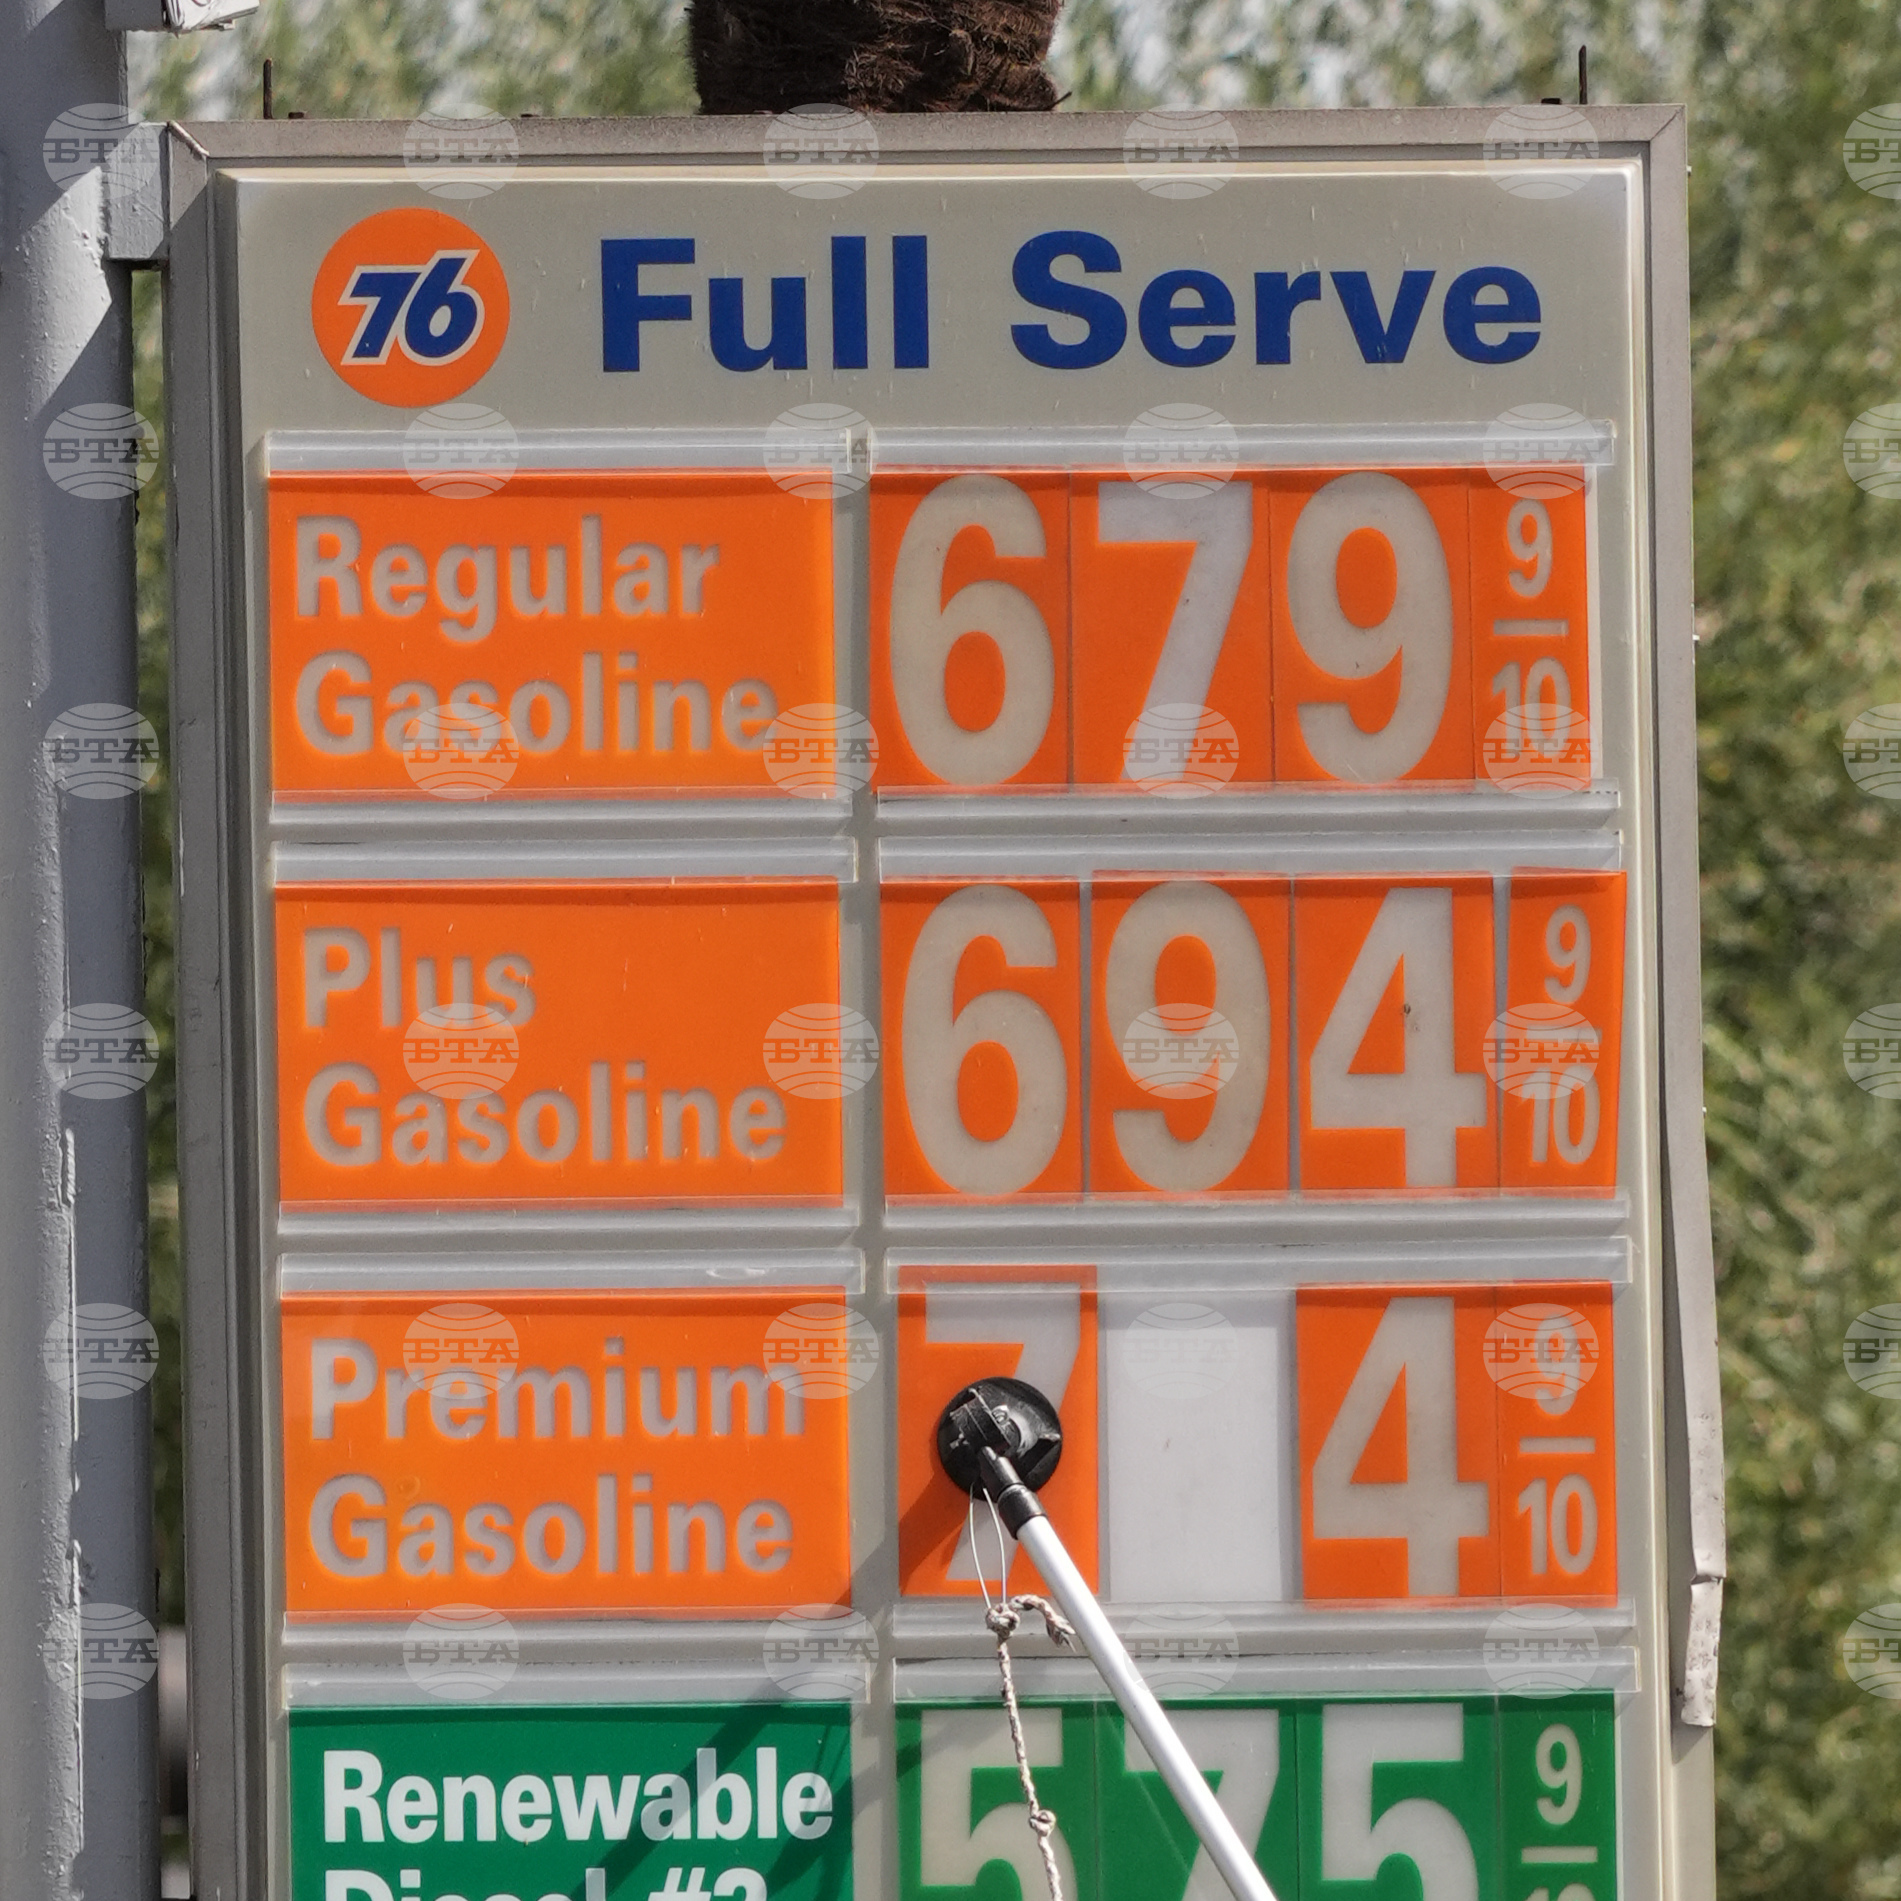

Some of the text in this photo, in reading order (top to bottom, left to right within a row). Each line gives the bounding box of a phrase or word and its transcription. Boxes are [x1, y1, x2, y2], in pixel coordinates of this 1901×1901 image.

[339, 248, 485, 367] 76
[600, 230, 1543, 373] Full Serve
[295, 514, 720, 643] Regular
[889, 470, 1455, 786] 679
[295, 649, 779, 756] Gasoline
[303, 925, 537, 1029] Plus
[901, 880, 1487, 1197] 694
[303, 1060, 788, 1168] Gasoline
[310, 1336, 806, 1441] Premium
[1311, 1295, 1490, 1597] 4
[308, 1472, 794, 1578] Gasoline
[322, 1746, 834, 1844] Renewable
